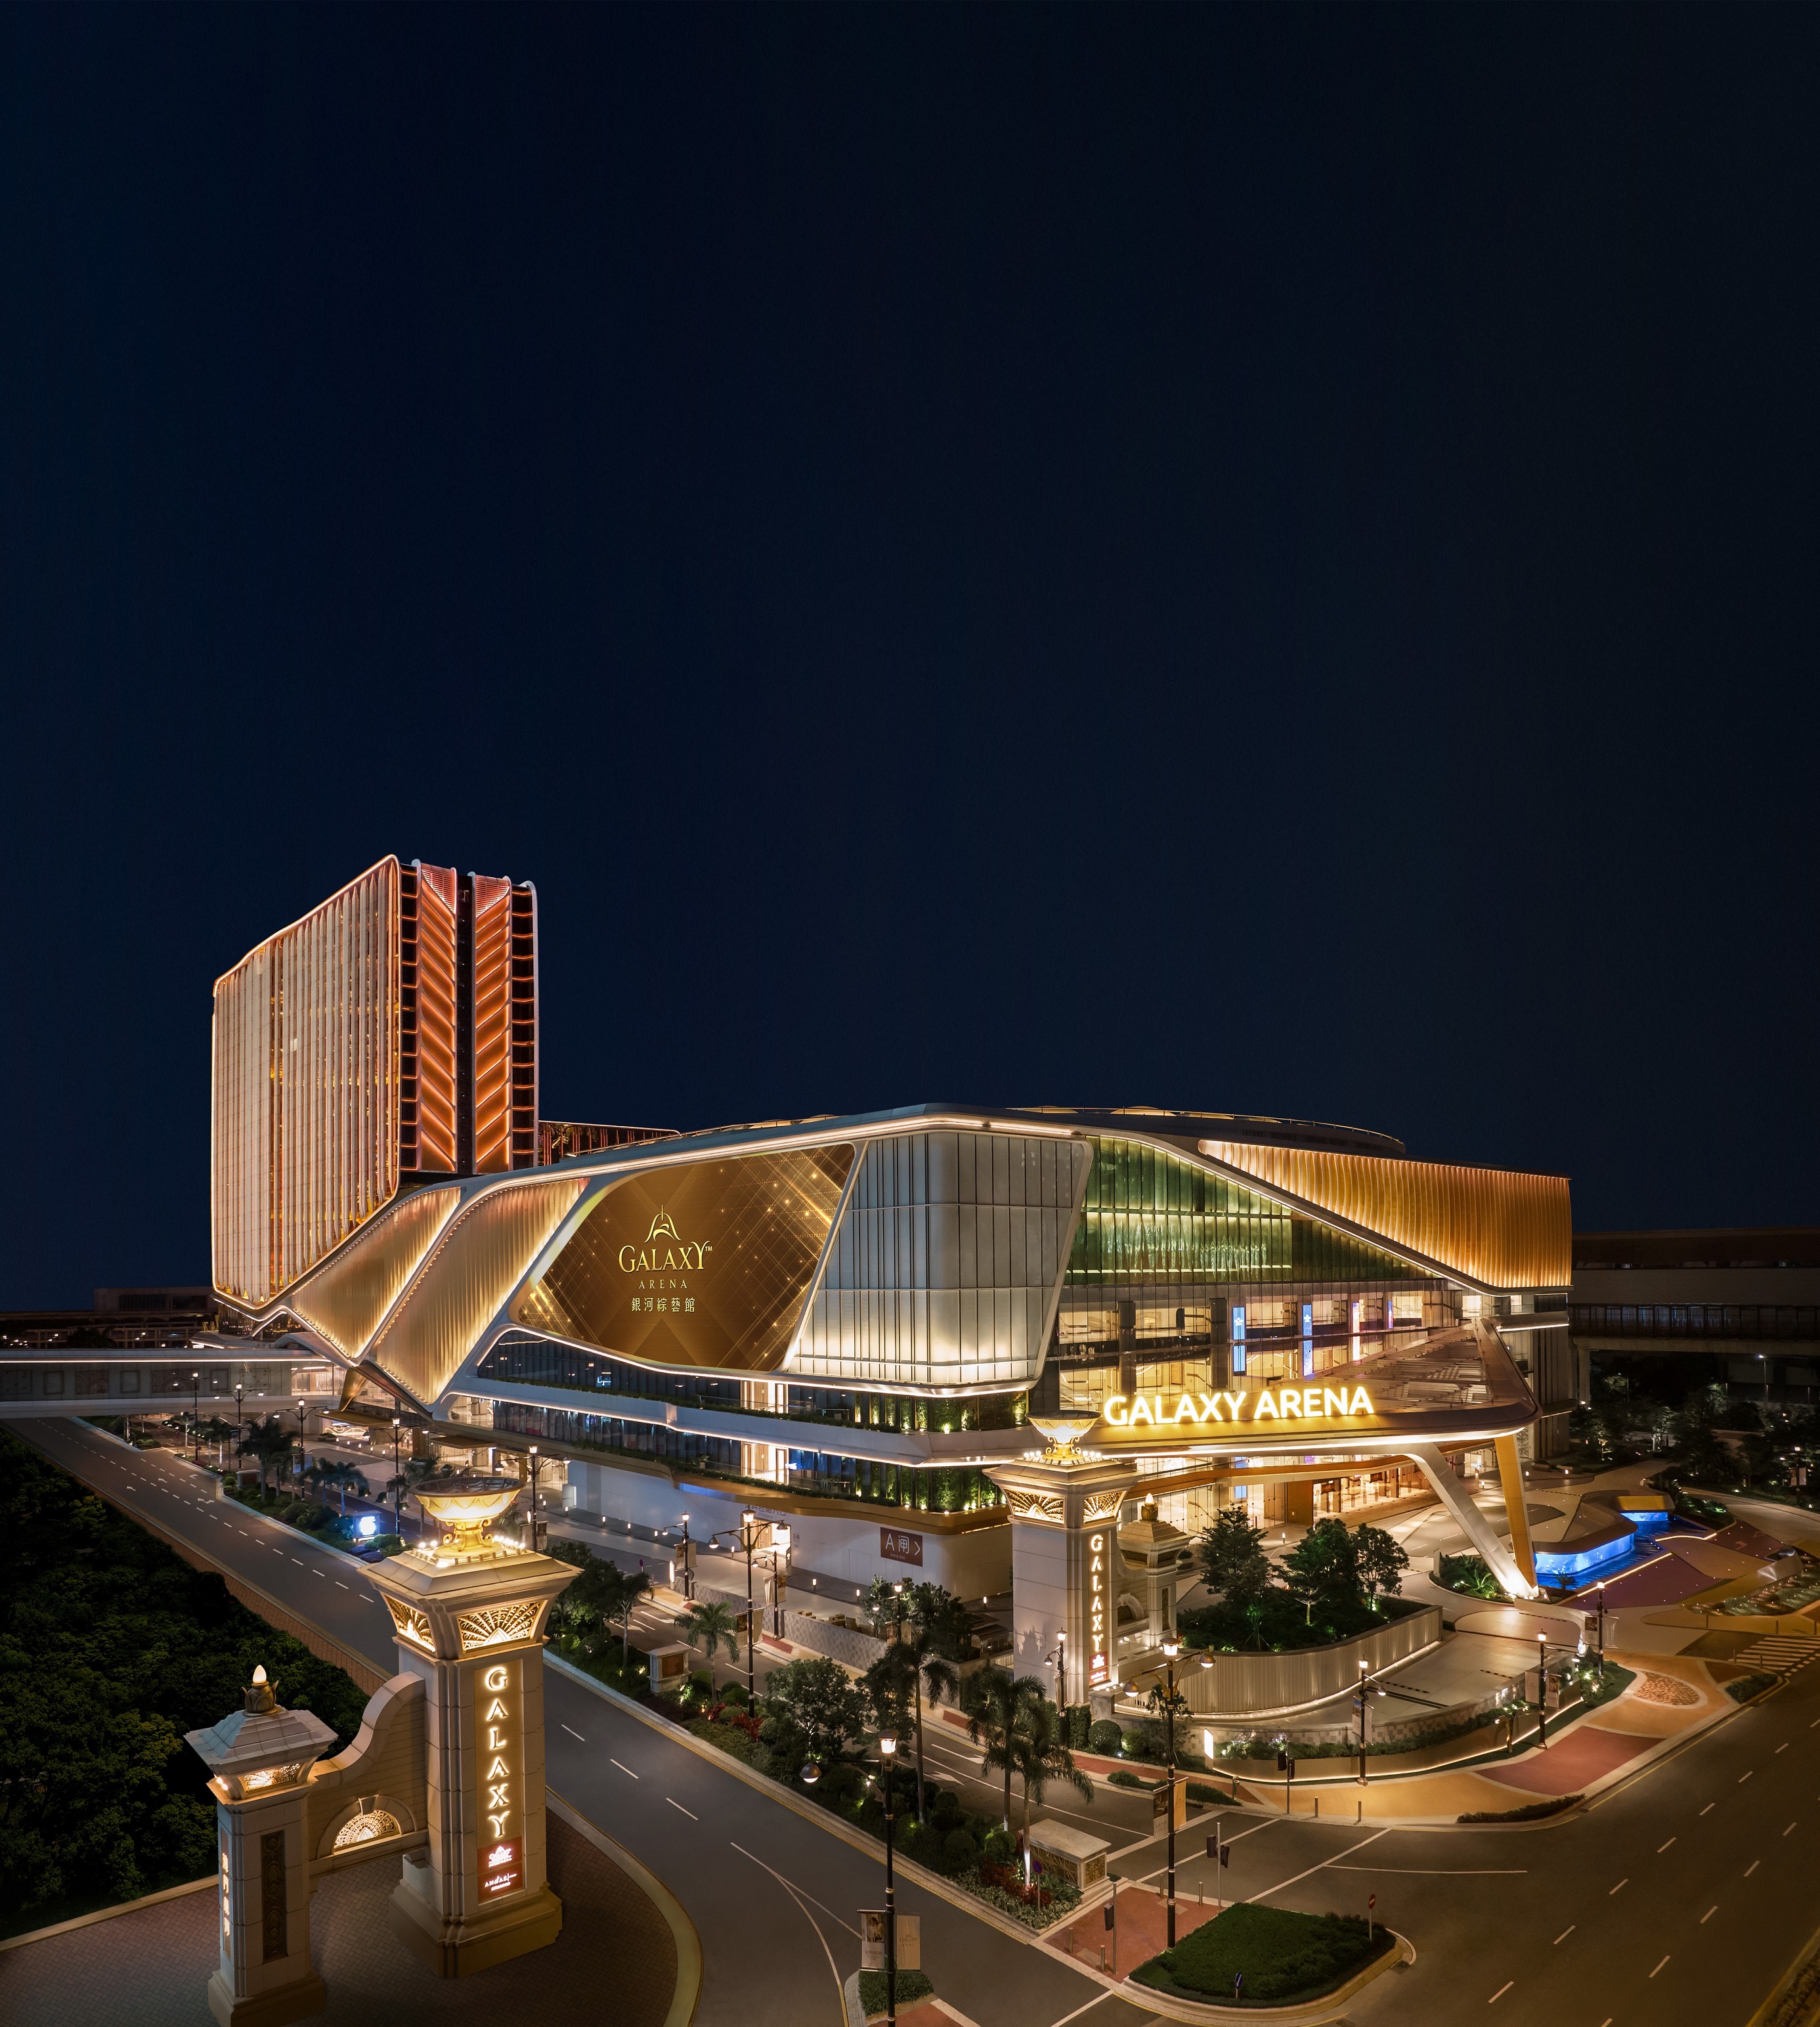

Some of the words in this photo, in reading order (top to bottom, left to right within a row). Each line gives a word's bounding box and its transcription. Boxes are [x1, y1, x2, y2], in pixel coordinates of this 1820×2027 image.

[618, 1240, 710, 1273] GALAXY
[639, 1279, 687, 1289] ARENA
[632, 1297, 695, 1313] 銀河綜藝館
[1103, 1391, 1247, 1426] GALAXY
[1253, 1385, 1375, 1420] ARENA
[1091, 1534, 1104, 1652] GALAXY
[485, 1667, 510, 1838] GALAXY
